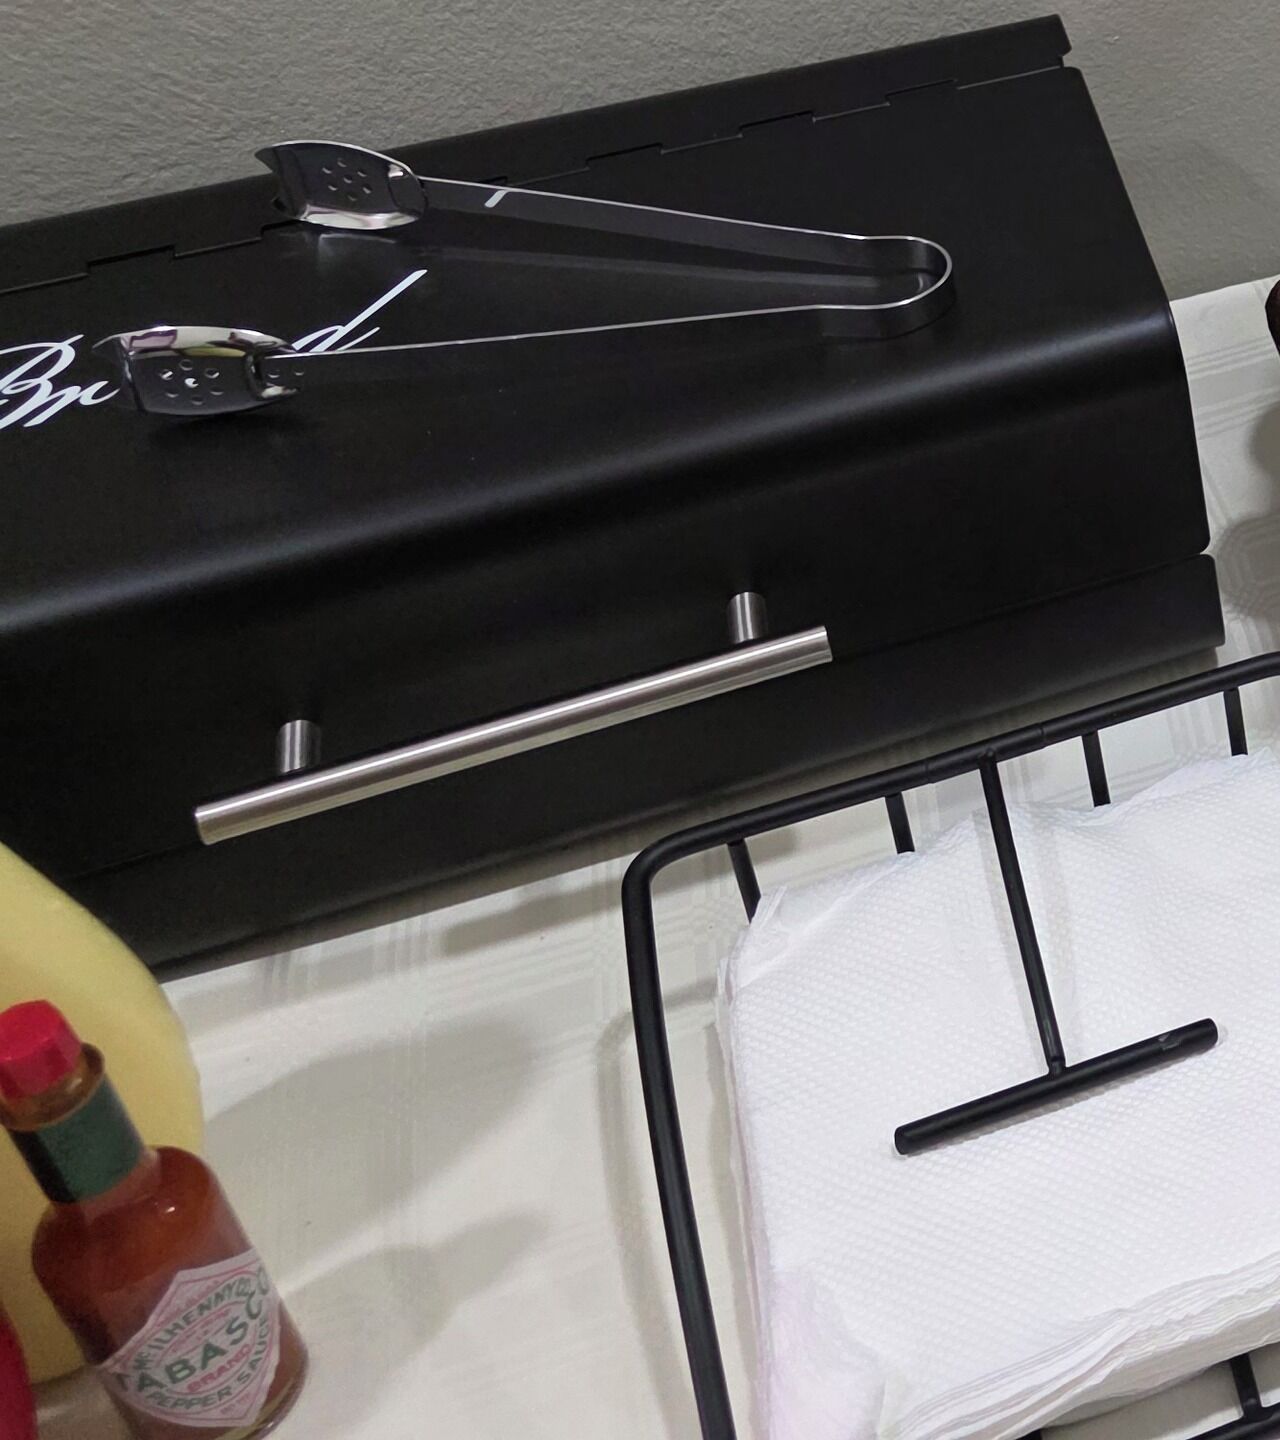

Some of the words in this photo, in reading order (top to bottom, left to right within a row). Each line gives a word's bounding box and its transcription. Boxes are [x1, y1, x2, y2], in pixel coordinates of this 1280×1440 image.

[146, 1385, 233, 1410] PEPPER
[237, 1317, 271, 1385] SAUCE
[187, 1343, 251, 1393] BRAND
